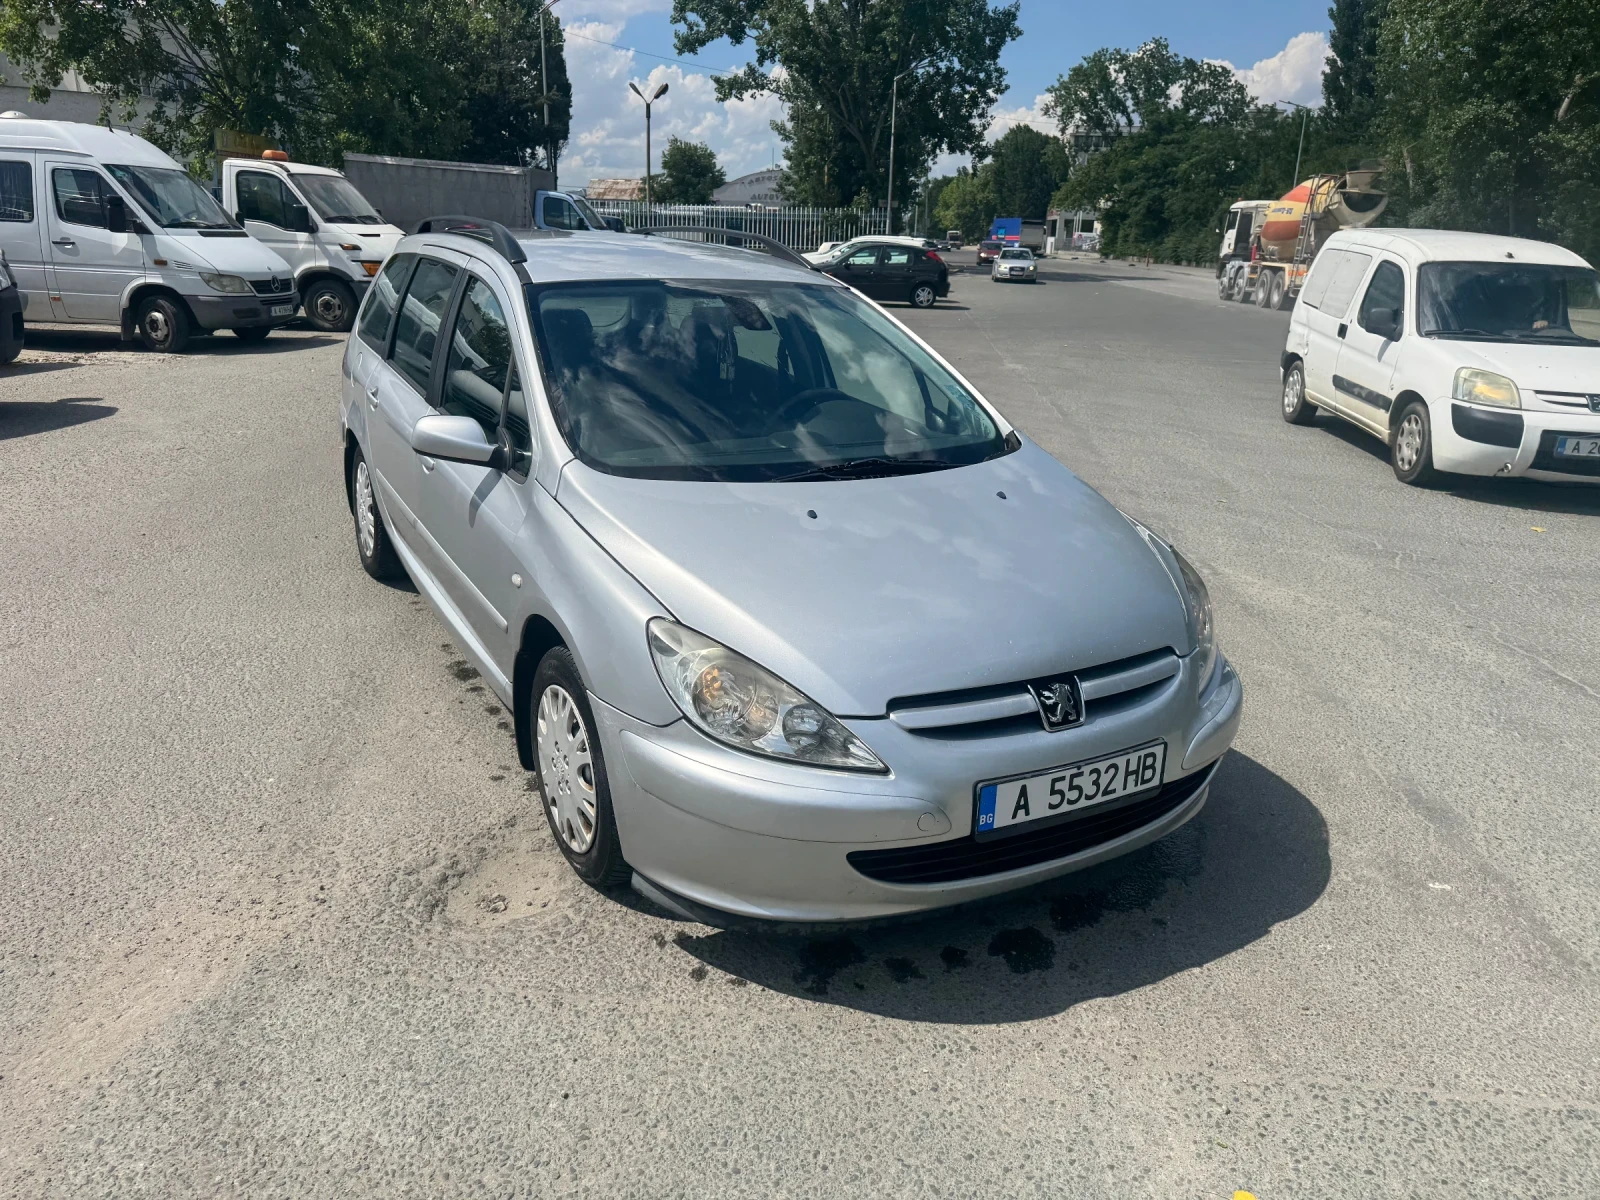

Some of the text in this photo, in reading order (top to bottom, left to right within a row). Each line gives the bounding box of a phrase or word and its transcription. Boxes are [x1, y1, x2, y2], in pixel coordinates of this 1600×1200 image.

[750, 193, 783, 201] AUTOV
[1571, 440, 1580, 453] A
[1012, 751, 1157, 819] A 5532 HB
[980, 813, 994, 826] BG
